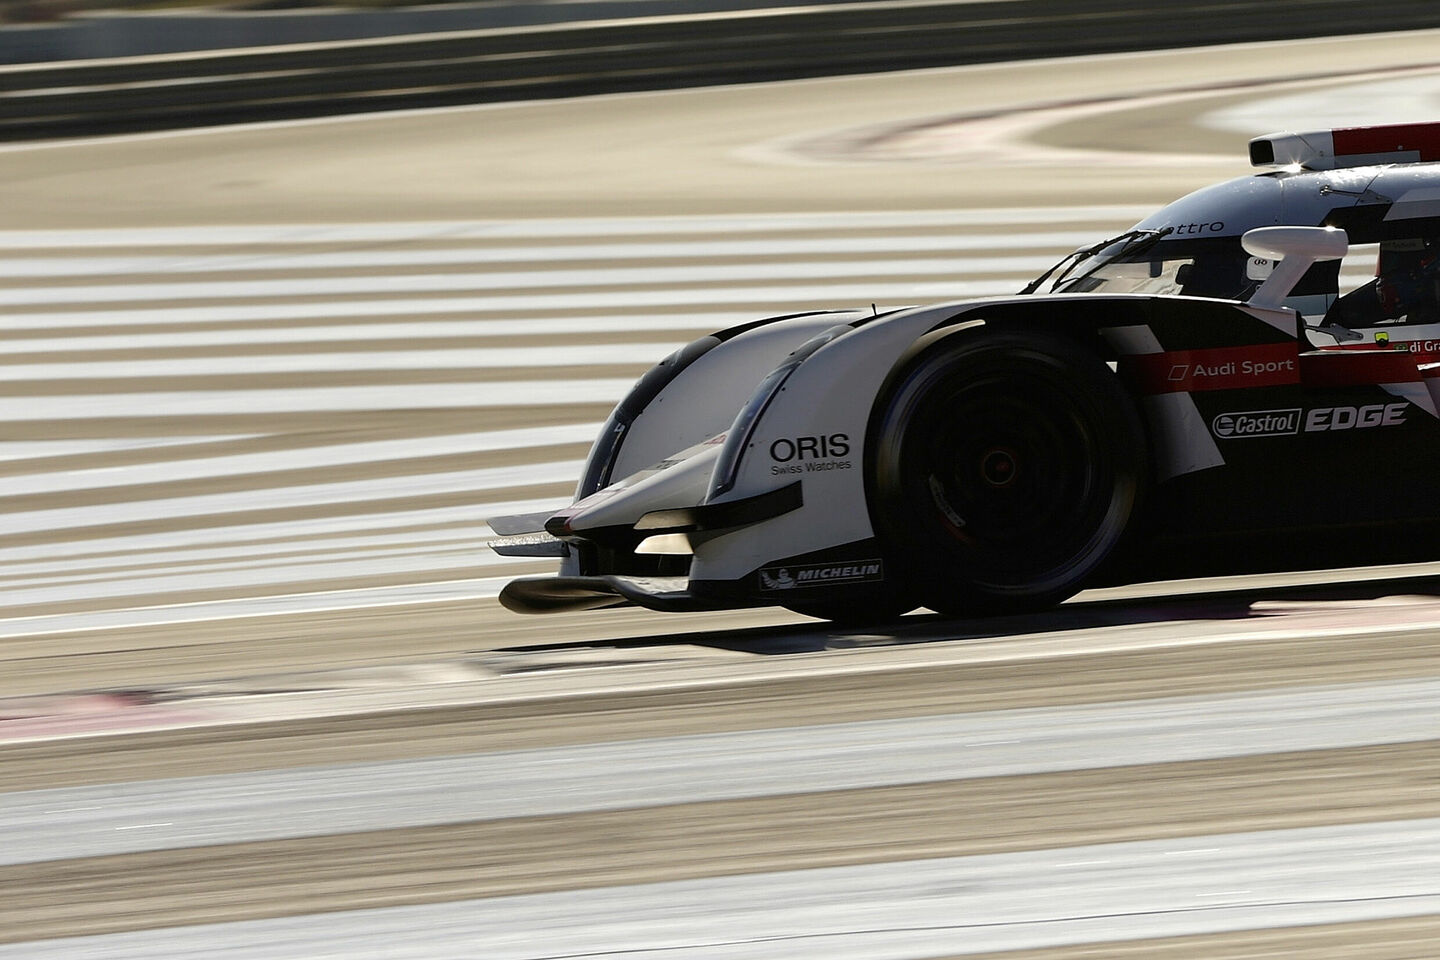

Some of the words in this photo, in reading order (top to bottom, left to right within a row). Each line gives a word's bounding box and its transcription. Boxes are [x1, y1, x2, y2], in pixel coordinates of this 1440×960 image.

[1409, 342, 1422, 353] di
[1193, 362, 1236, 377] Audi
[1242, 358, 1294, 375] Sport
[1234, 413, 1294, 434] Castrol
[1304, 402, 1410, 432] EDGE
[769, 433, 850, 463] ORIS
[771, 466, 803, 476] Swiss
[805, 460, 852, 472] Watches
[797, 564, 880, 581] MICHELIN
